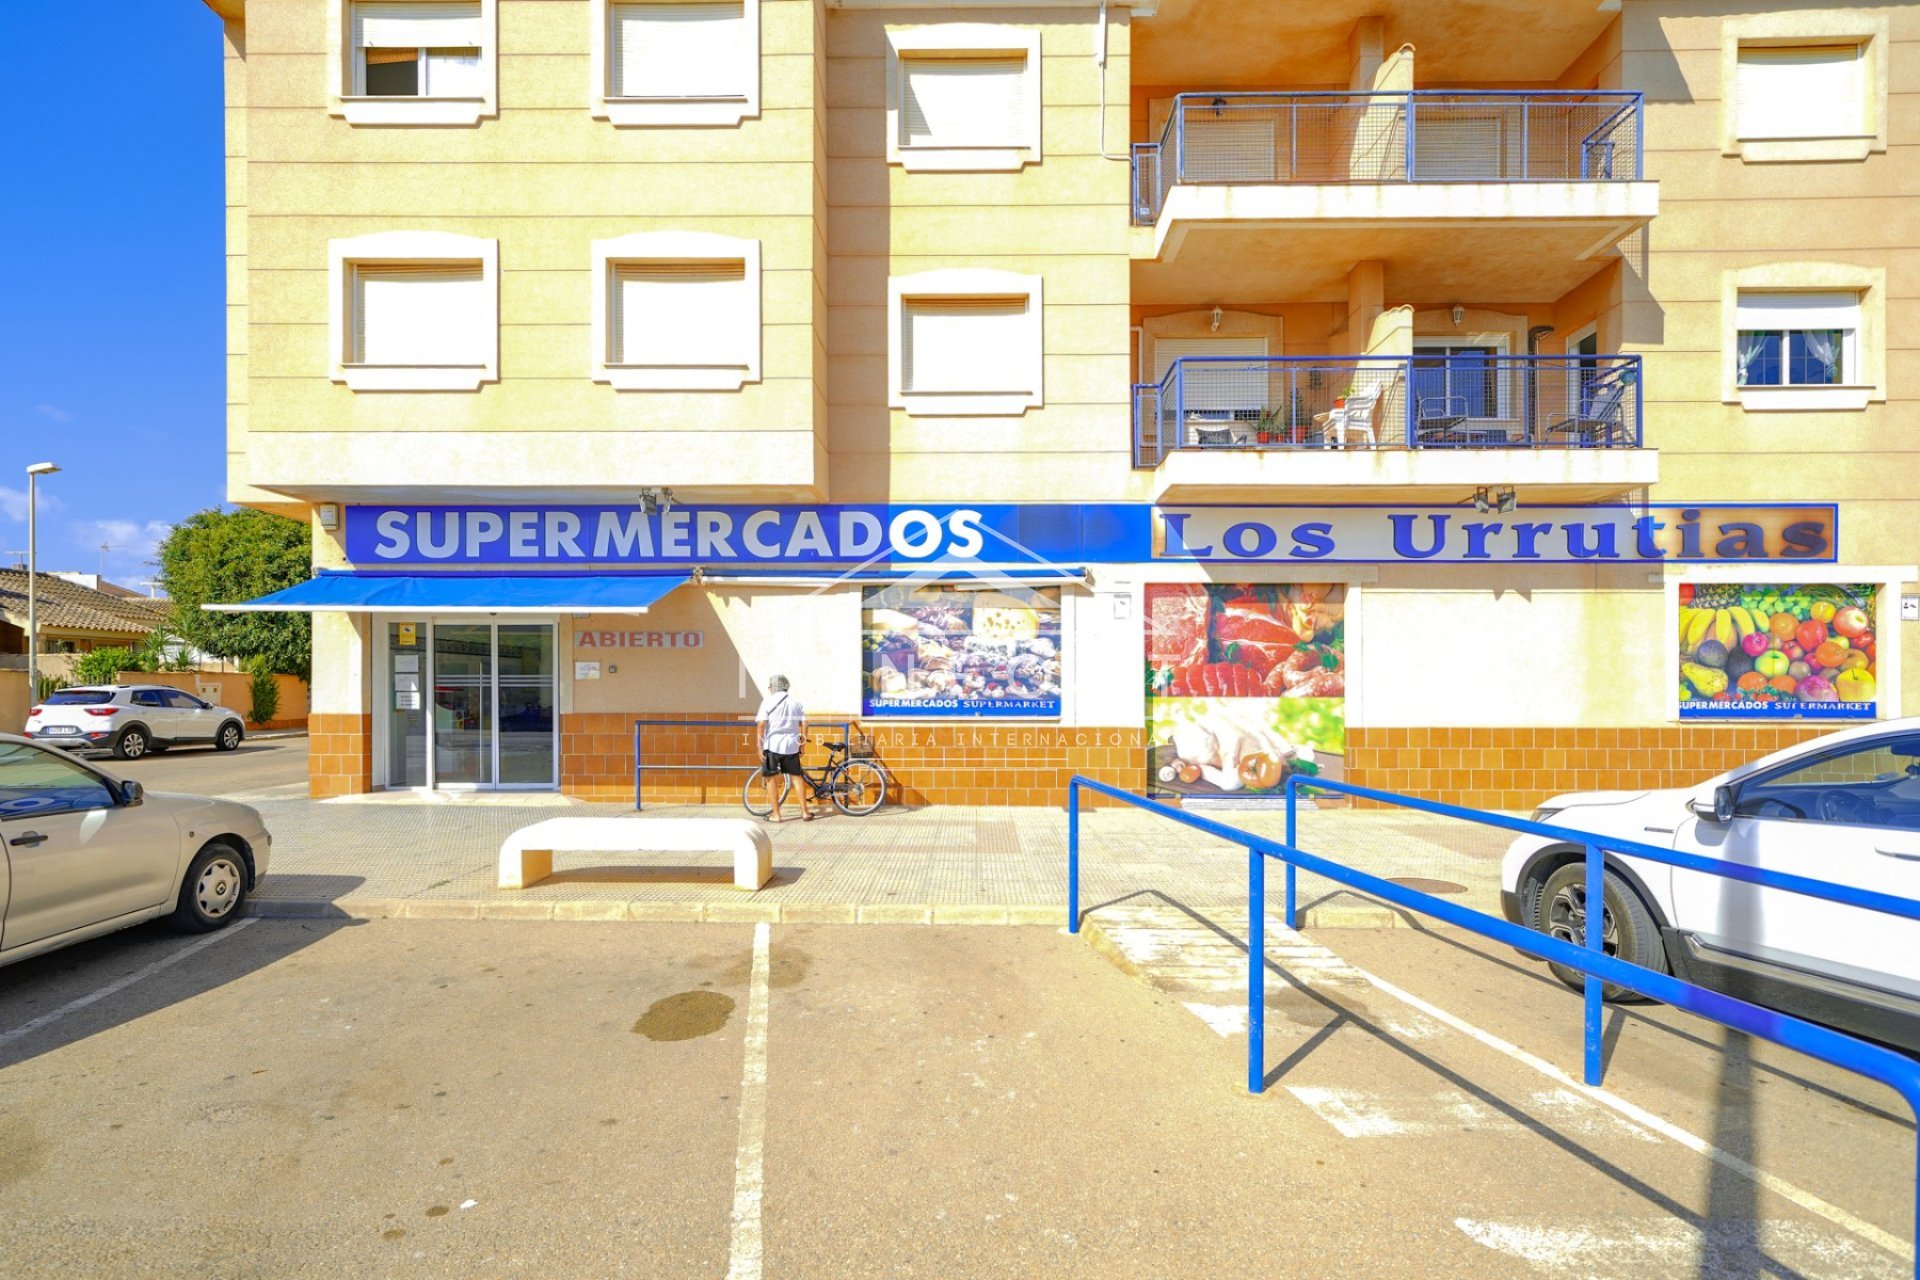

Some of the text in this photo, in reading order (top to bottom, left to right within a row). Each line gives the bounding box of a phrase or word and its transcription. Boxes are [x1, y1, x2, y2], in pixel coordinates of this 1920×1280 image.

[374, 509, 984, 560] SUPERMERCADOS
[1159, 508, 1828, 560] Los Urrutias
[579, 631, 700, 648] ABIERTO
[869, 698, 1056, 709] SUPERMERCADOS SUPERMARKET
